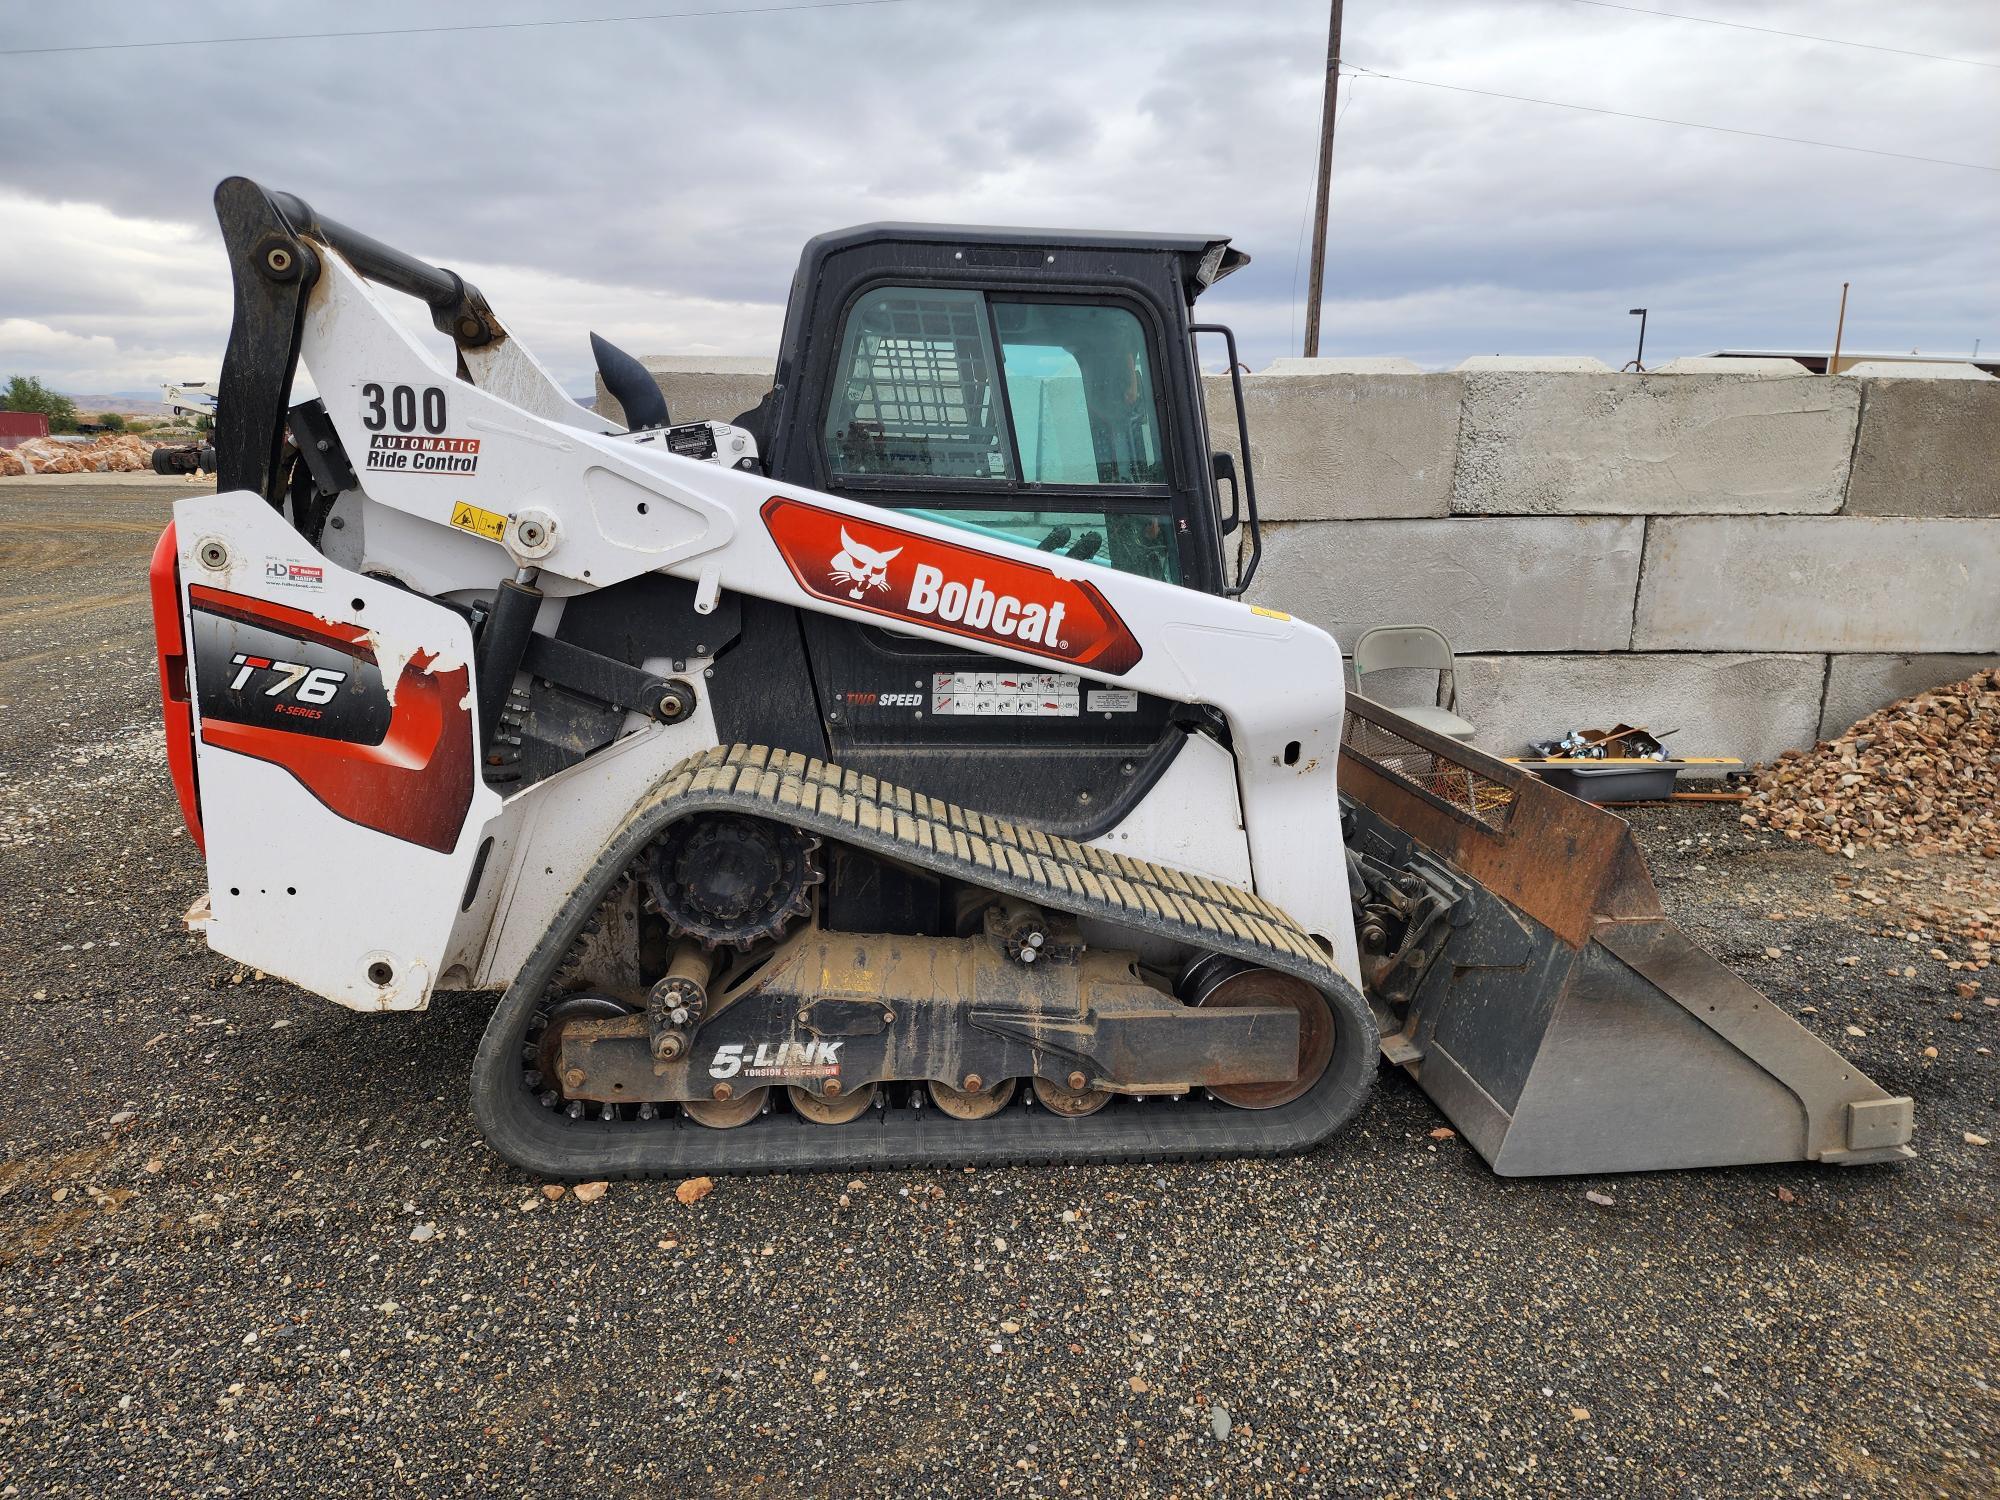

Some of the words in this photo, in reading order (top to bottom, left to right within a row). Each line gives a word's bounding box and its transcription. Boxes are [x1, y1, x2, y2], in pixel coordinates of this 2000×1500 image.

[362, 383, 447, 434] 300
[374, 437, 476, 452] AUTOMATIC
[366, 451, 407, 468] Ride
[412, 453, 479, 472] Control
[907, 563, 1066, 648] Bobcat
[229, 653, 348, 705] T76
[846, 694, 877, 705] TWO
[878, 693, 923, 706] SPEED
[274, 704, 323, 719] R-SERIES
[708, 1042, 844, 1078] 5-LINK
[744, 1067, 781, 1077] TORSION
